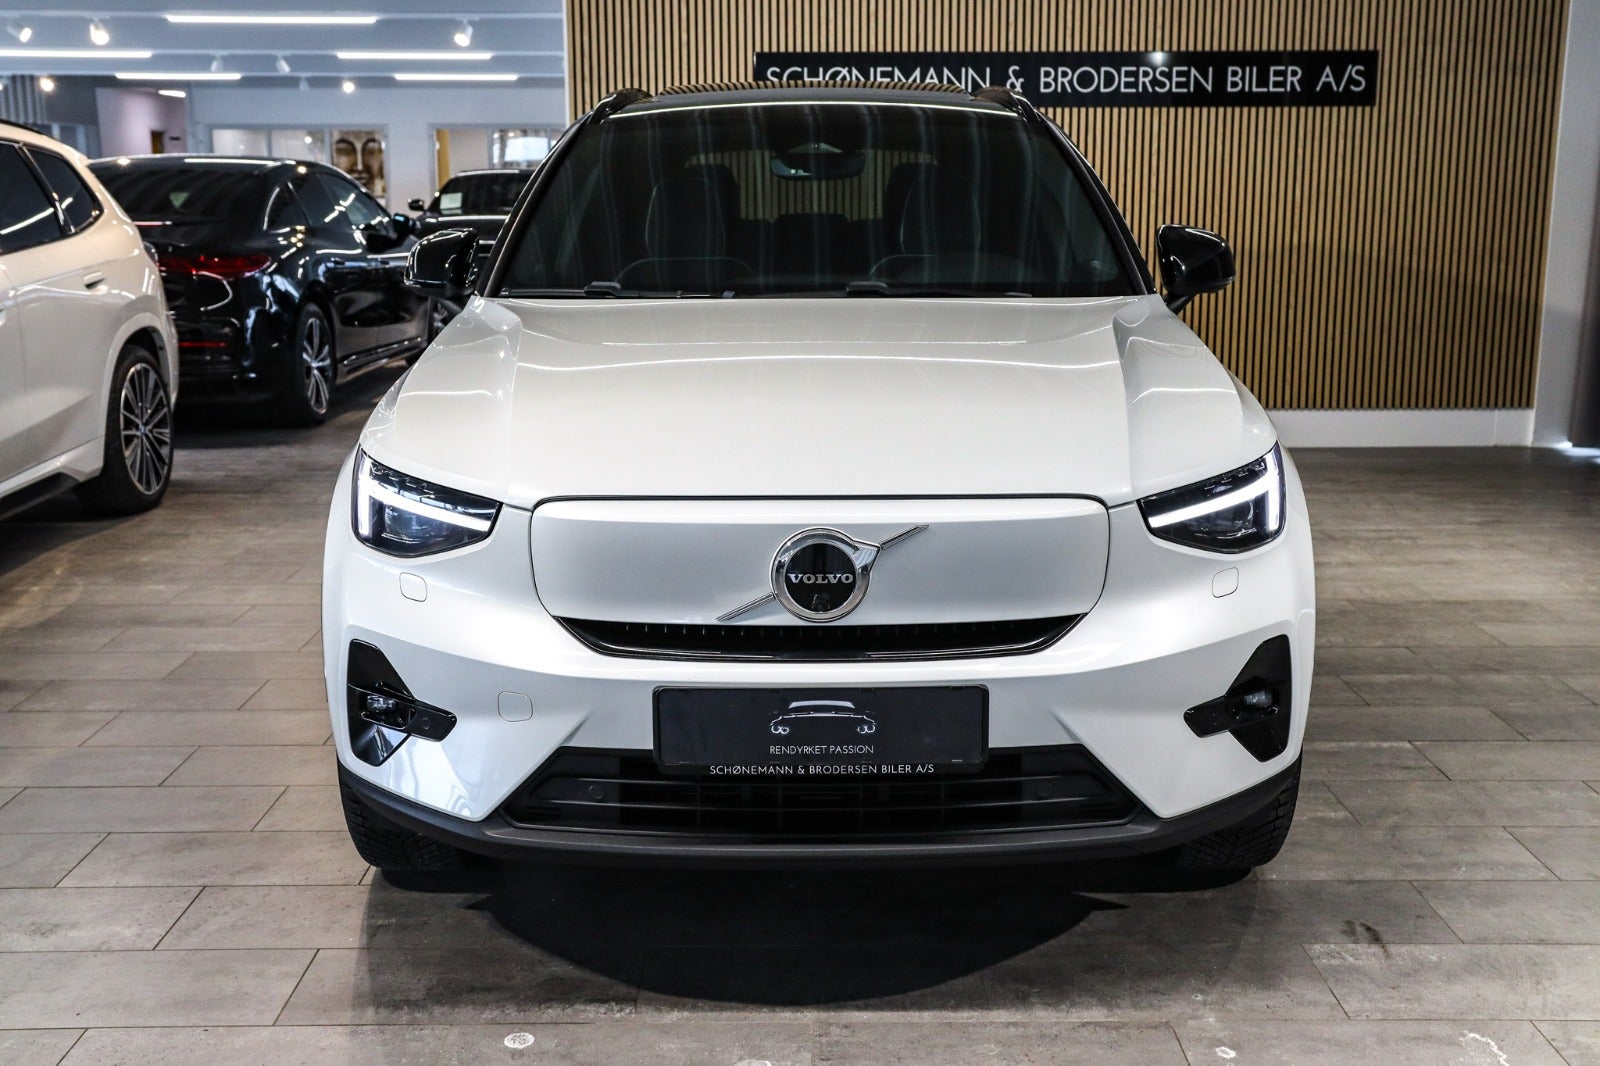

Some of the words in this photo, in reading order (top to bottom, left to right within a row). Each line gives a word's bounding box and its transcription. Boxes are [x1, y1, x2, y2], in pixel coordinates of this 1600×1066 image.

[1006, 65, 1025, 93] &
[1039, 66, 1213, 93] BRODERSEN
[1227, 65, 1302, 92] BILER
[1316, 64, 1366, 92] A/S
[787, 573, 854, 584] VOLVO
[769, 745, 827, 755] RENDYRKET
[829, 745, 874, 755] PASSION
[709, 765, 793, 775] SCHØNEMANN
[797, 765, 806, 775] &
[809, 765, 877, 775] BRODERSEN
[881, 764, 912, 774] BILER
[915, 763, 935, 774] A/S
